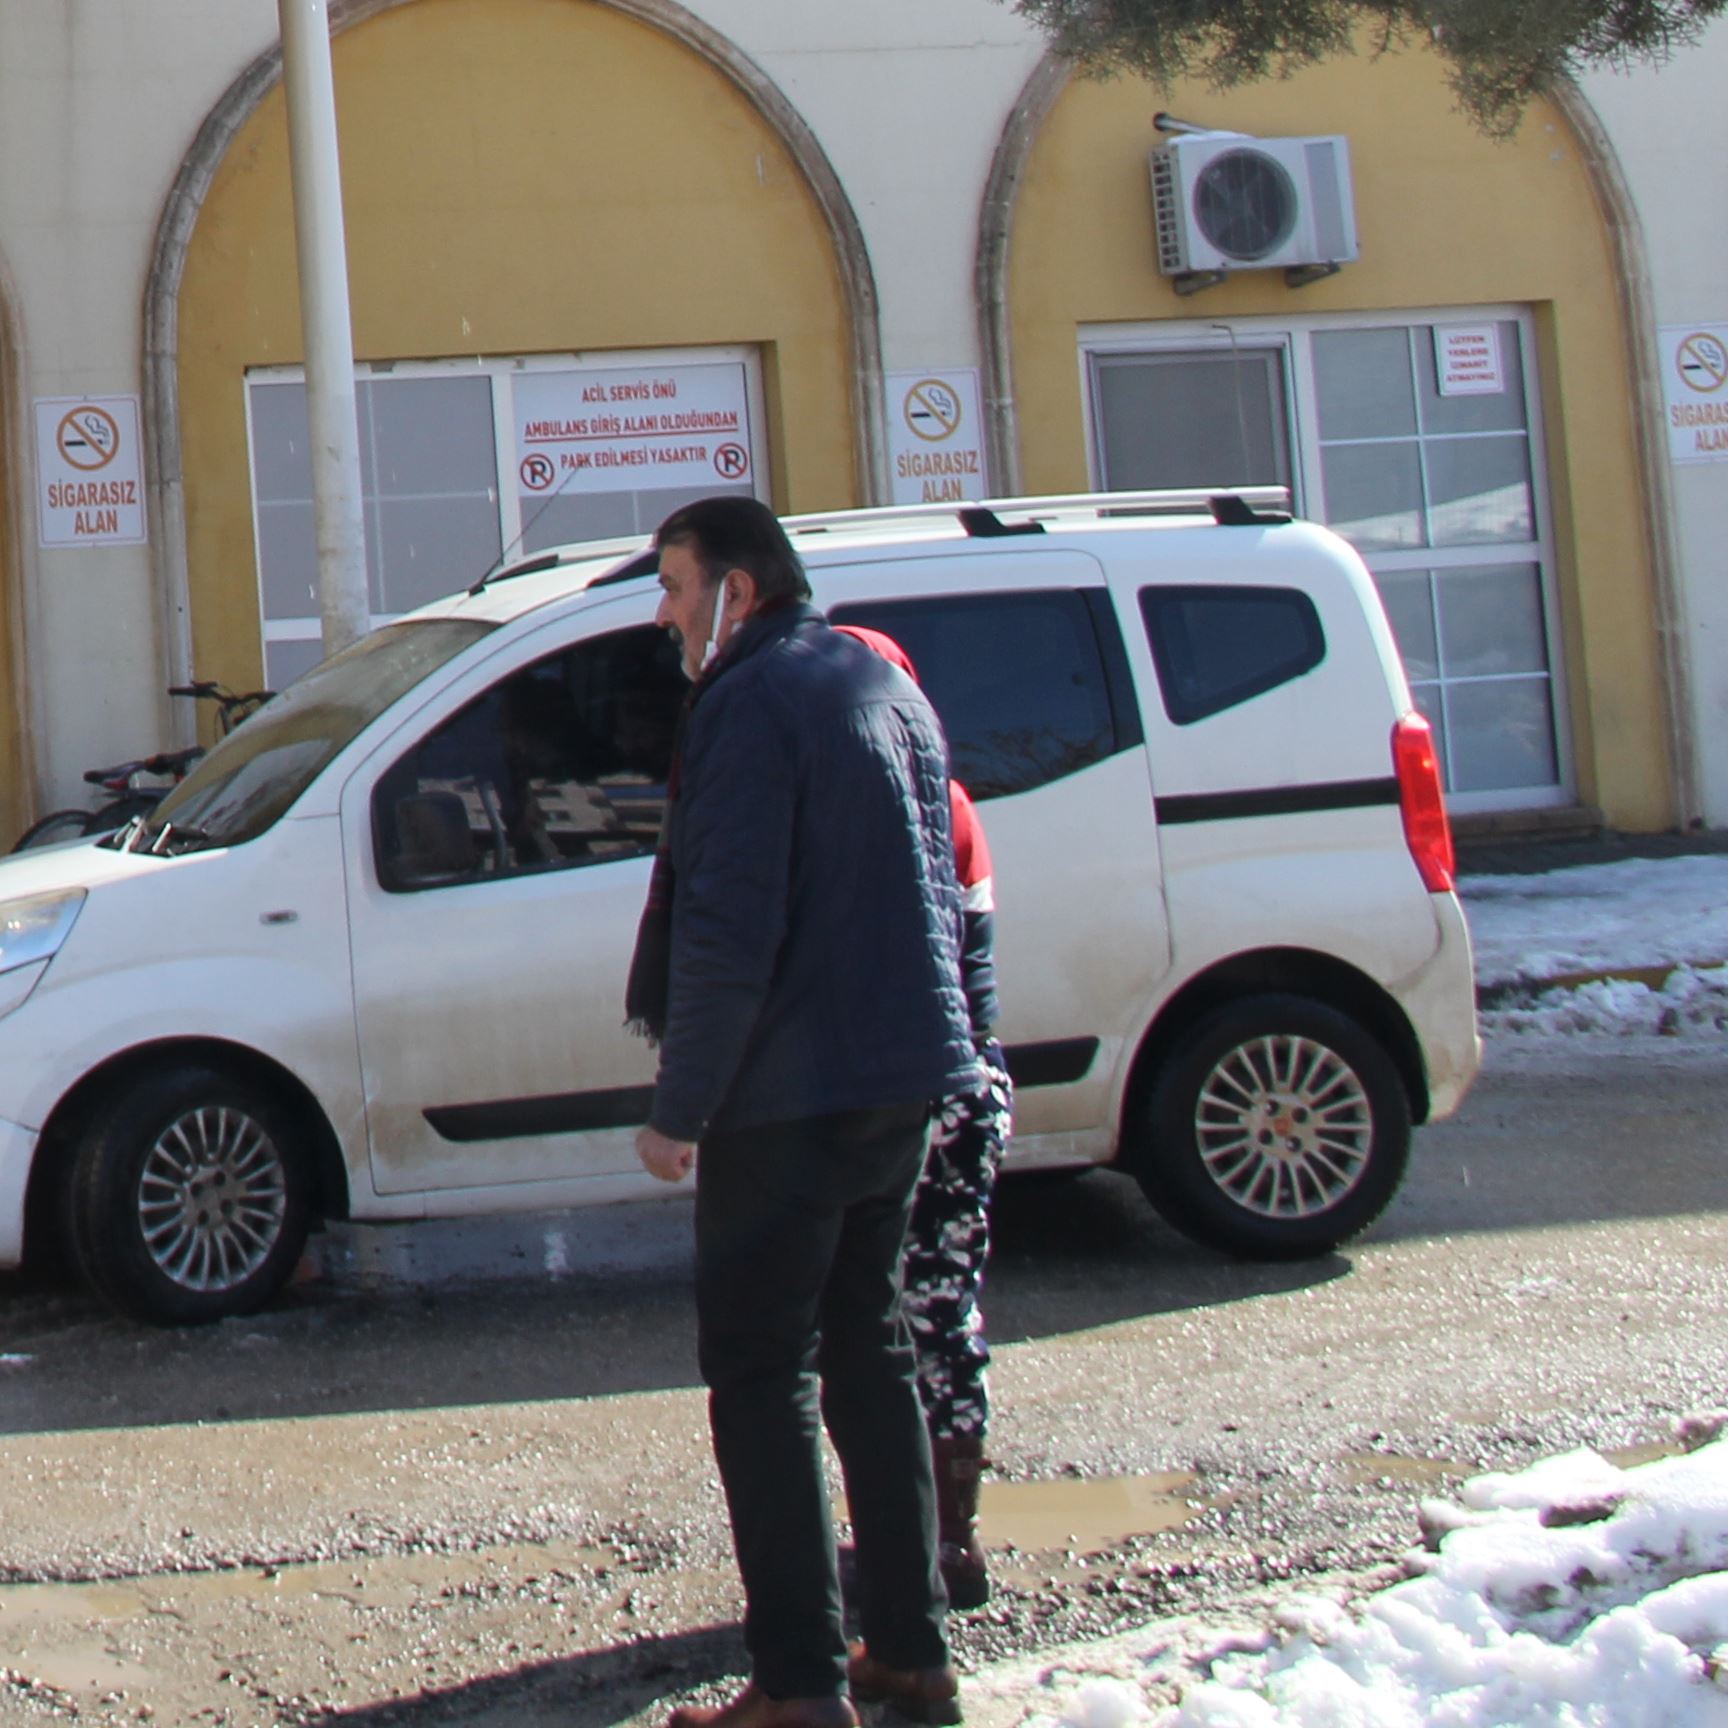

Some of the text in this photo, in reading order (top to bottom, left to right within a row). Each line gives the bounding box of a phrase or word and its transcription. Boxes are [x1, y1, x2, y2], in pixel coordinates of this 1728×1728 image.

[582, 378, 677, 403] ACİL SERVİS ÖNÜ
[525, 409, 738, 438] AMBULANS GİRİŞ ALANI OLDUĞUNDAN
[560, 445, 707, 469] PARK EDİLMESİ YASAKTIR
[897, 449, 978, 478] SİGARASIZ
[48, 478, 136, 508] SİGARASIZ
[922, 478, 962, 502] ALAN
[74, 509, 118, 534] ALAN
